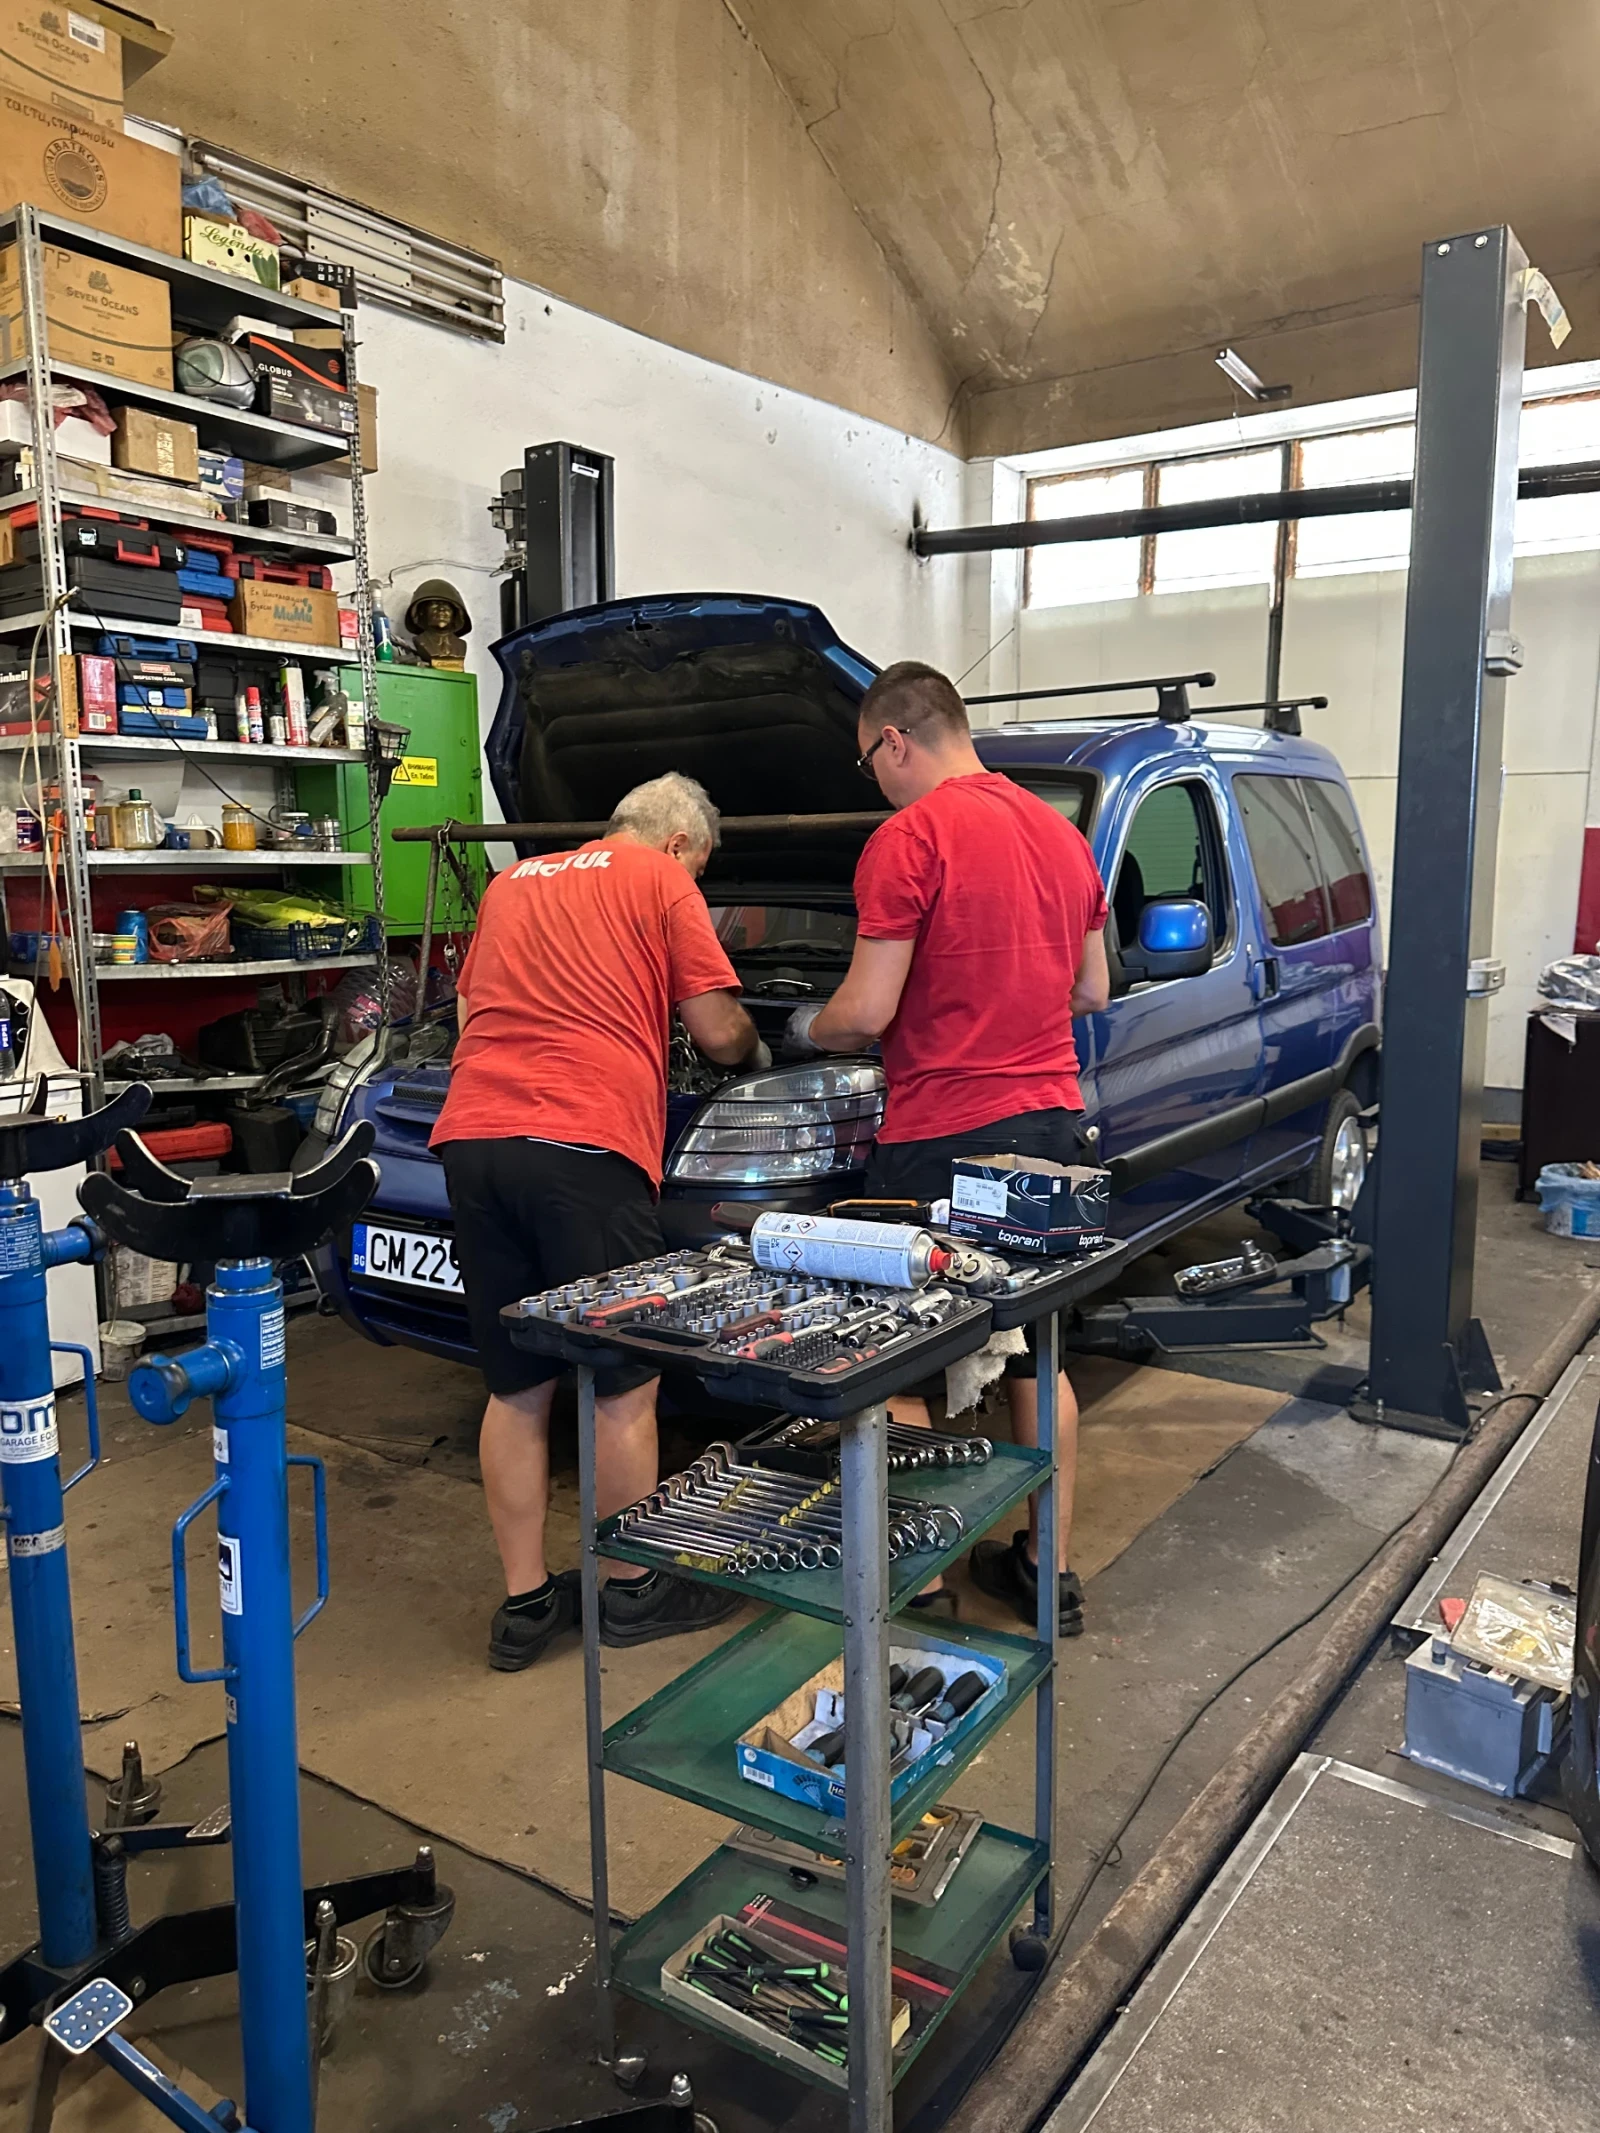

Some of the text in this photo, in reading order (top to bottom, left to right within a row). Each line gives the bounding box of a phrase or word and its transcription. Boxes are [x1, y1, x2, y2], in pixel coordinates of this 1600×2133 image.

[66, 286, 98, 304] SEVEN
[101, 296, 140, 316] OCEANS
[258, 363, 293, 378] GLOBUS
[1, 1023, 9, 1048] PEPSI
[997, 1228, 1041, 1248] topran
[1078, 1233, 1104, 1249] topran
[353, 1254, 365, 1267] BG
[0, 1435, 39, 1447] GARAGE
